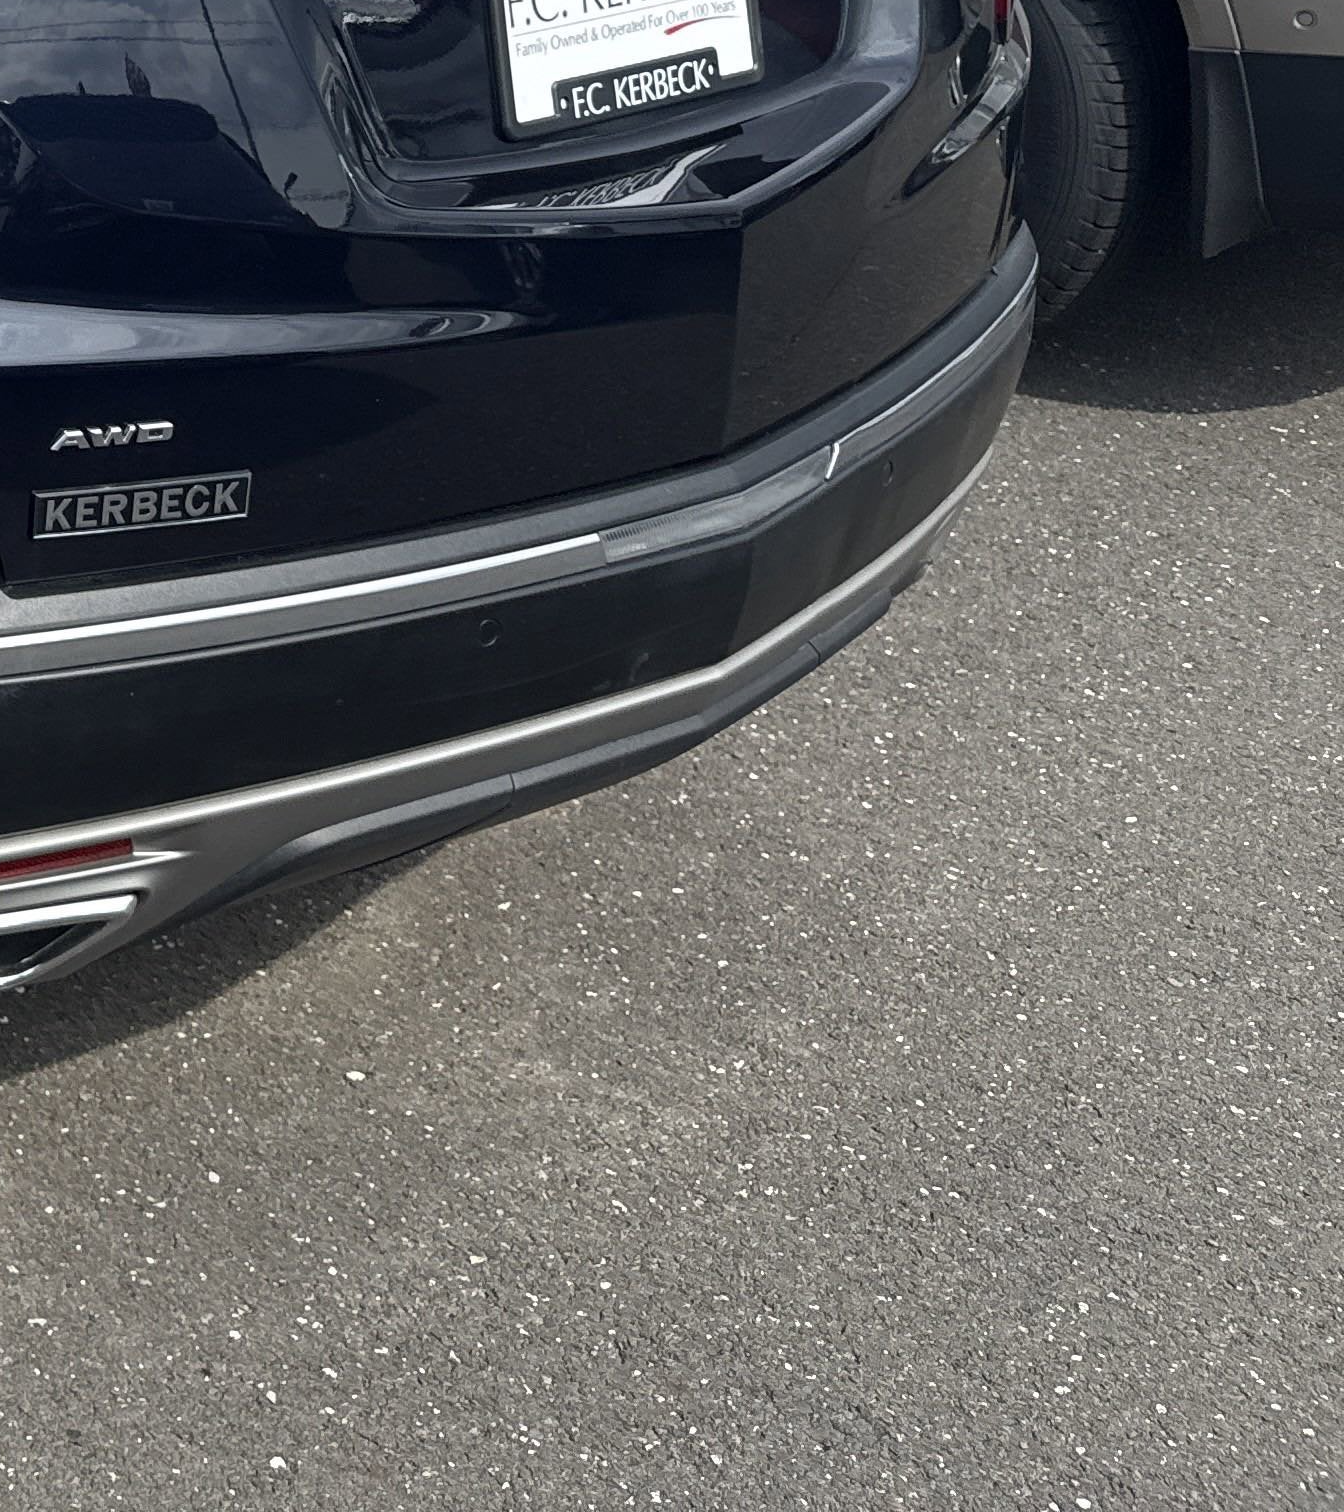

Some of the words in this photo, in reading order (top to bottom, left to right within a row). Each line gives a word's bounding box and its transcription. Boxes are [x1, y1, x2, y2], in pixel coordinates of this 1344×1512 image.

[515, 38, 548, 58] Family
[550, 29, 589, 51] Owned
[591, 29, 599, 43] &
[601, 19, 648, 44] Operated
[648, 13, 664, 29] For
[665, 8, 690, 25] Over
[692, 2, 710, 18] 100
[571, 81, 611, 119] F.C.
[613, 57, 711, 110] KERBECK
[50, 420, 174, 451] AWD
[44, 481, 240, 532] KERBECK
